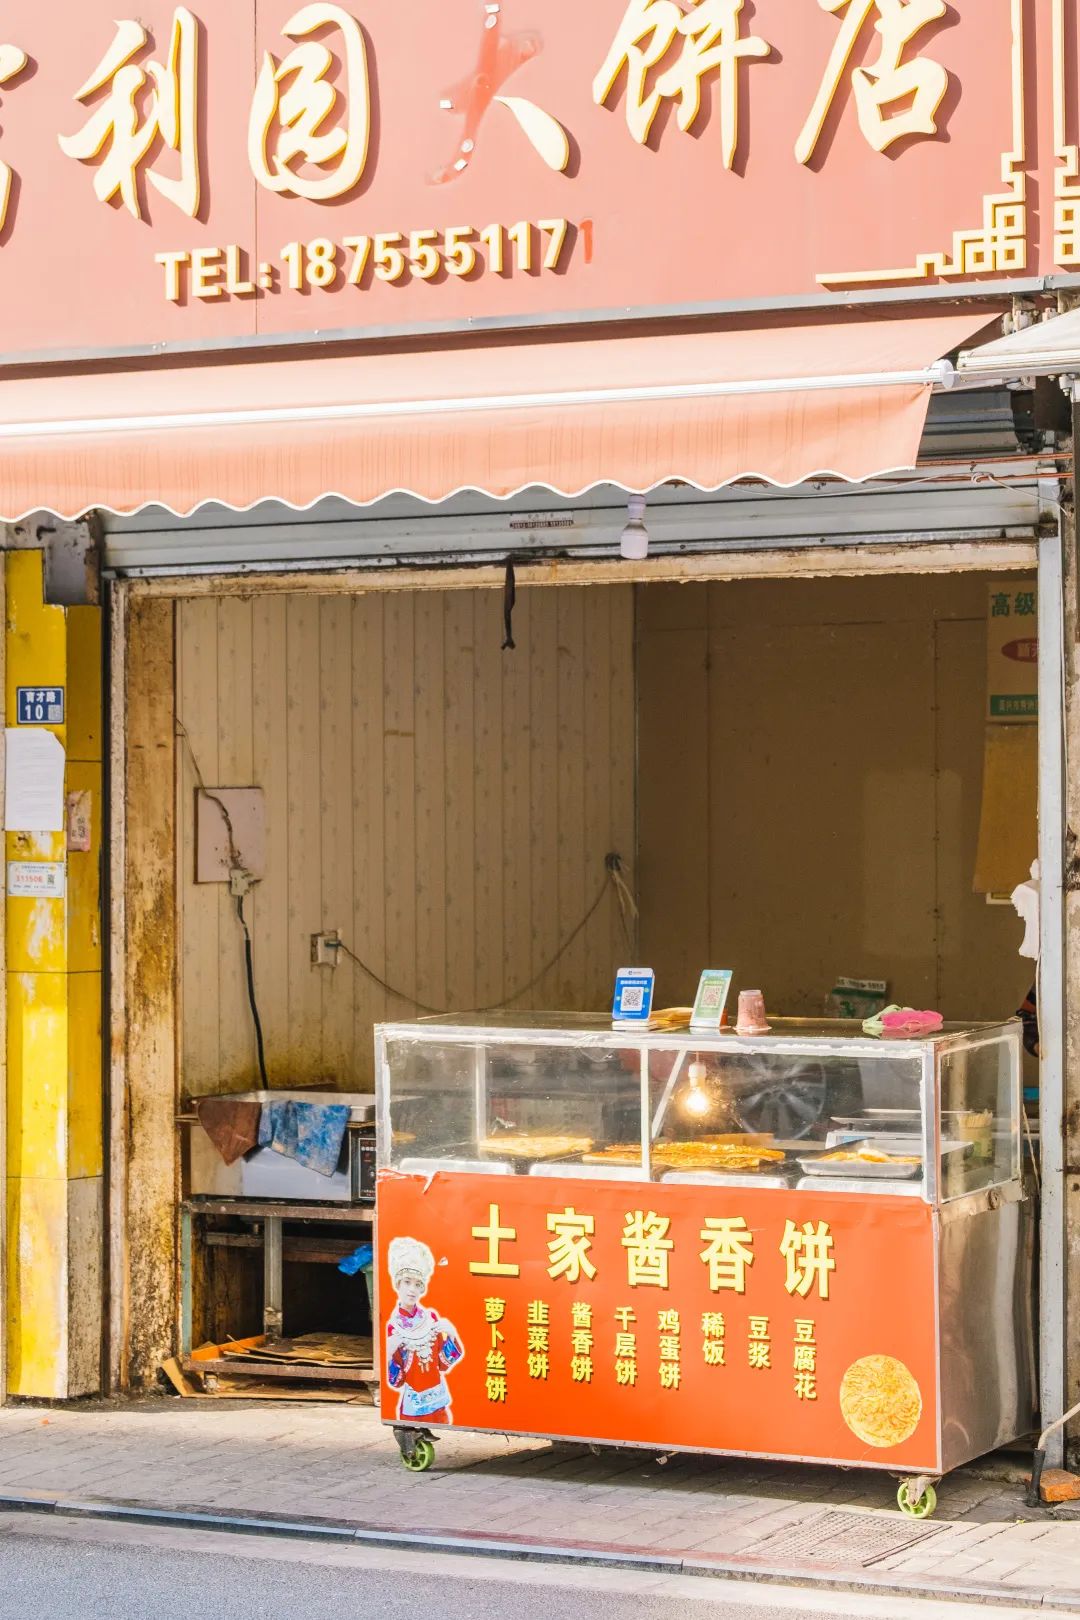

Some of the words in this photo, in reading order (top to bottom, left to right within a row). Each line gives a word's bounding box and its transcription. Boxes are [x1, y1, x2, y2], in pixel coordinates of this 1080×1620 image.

[25, 704, 44, 720] 10
[469, 1203, 836, 1298] 土家酱香饼
[484, 1297, 507, 1401] 萝卜丝饼
[527, 1300, 549, 1378] 韭菜饼
[570, 1302, 593, 1382] 酱香饼
[614, 1306, 637, 1385] 千层饼
[658, 1308, 681, 1388] 鸡蛋饼
[701, 1312, 726, 1364] 稀饭
[748, 1315, 771, 1368] 豆浆
[793, 1319, 817, 1399] 豆腐花
